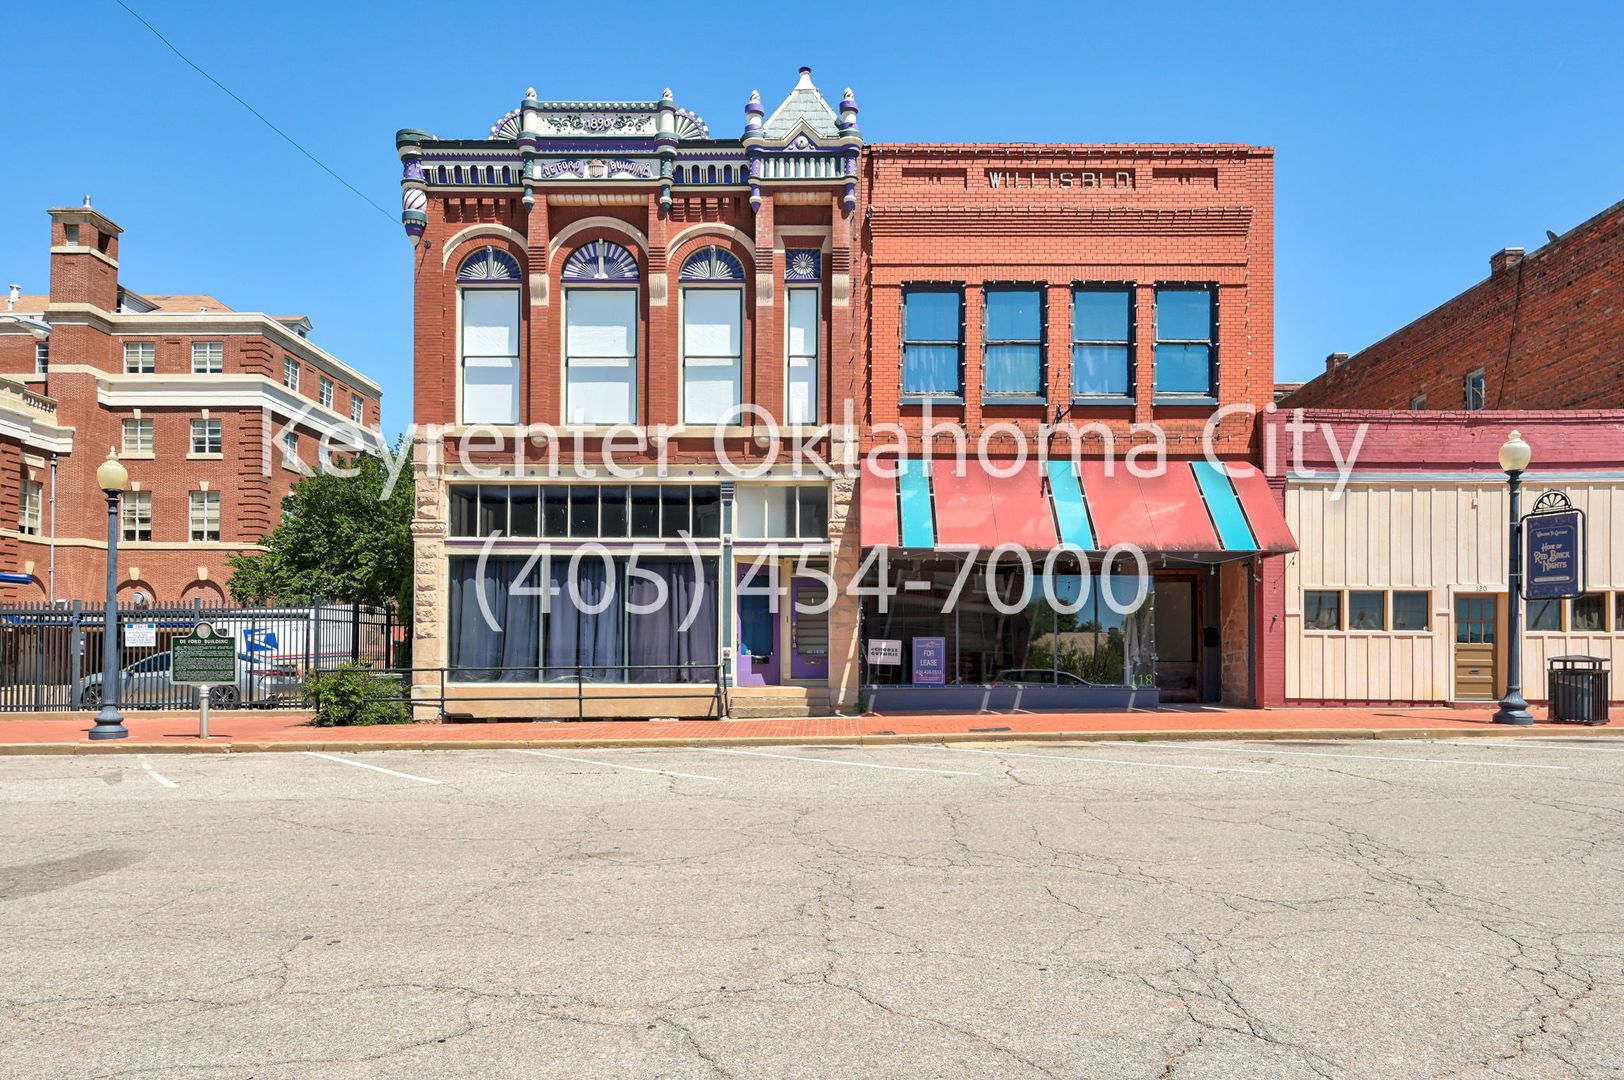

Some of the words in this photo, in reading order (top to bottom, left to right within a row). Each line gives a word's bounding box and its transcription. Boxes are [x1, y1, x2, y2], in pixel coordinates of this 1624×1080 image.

[585, 117, 611, 129] 1890
[557, 160, 581, 173] FORD
[610, 160, 651, 176] BUILDING
[1132, 674, 1153, 686] 118
